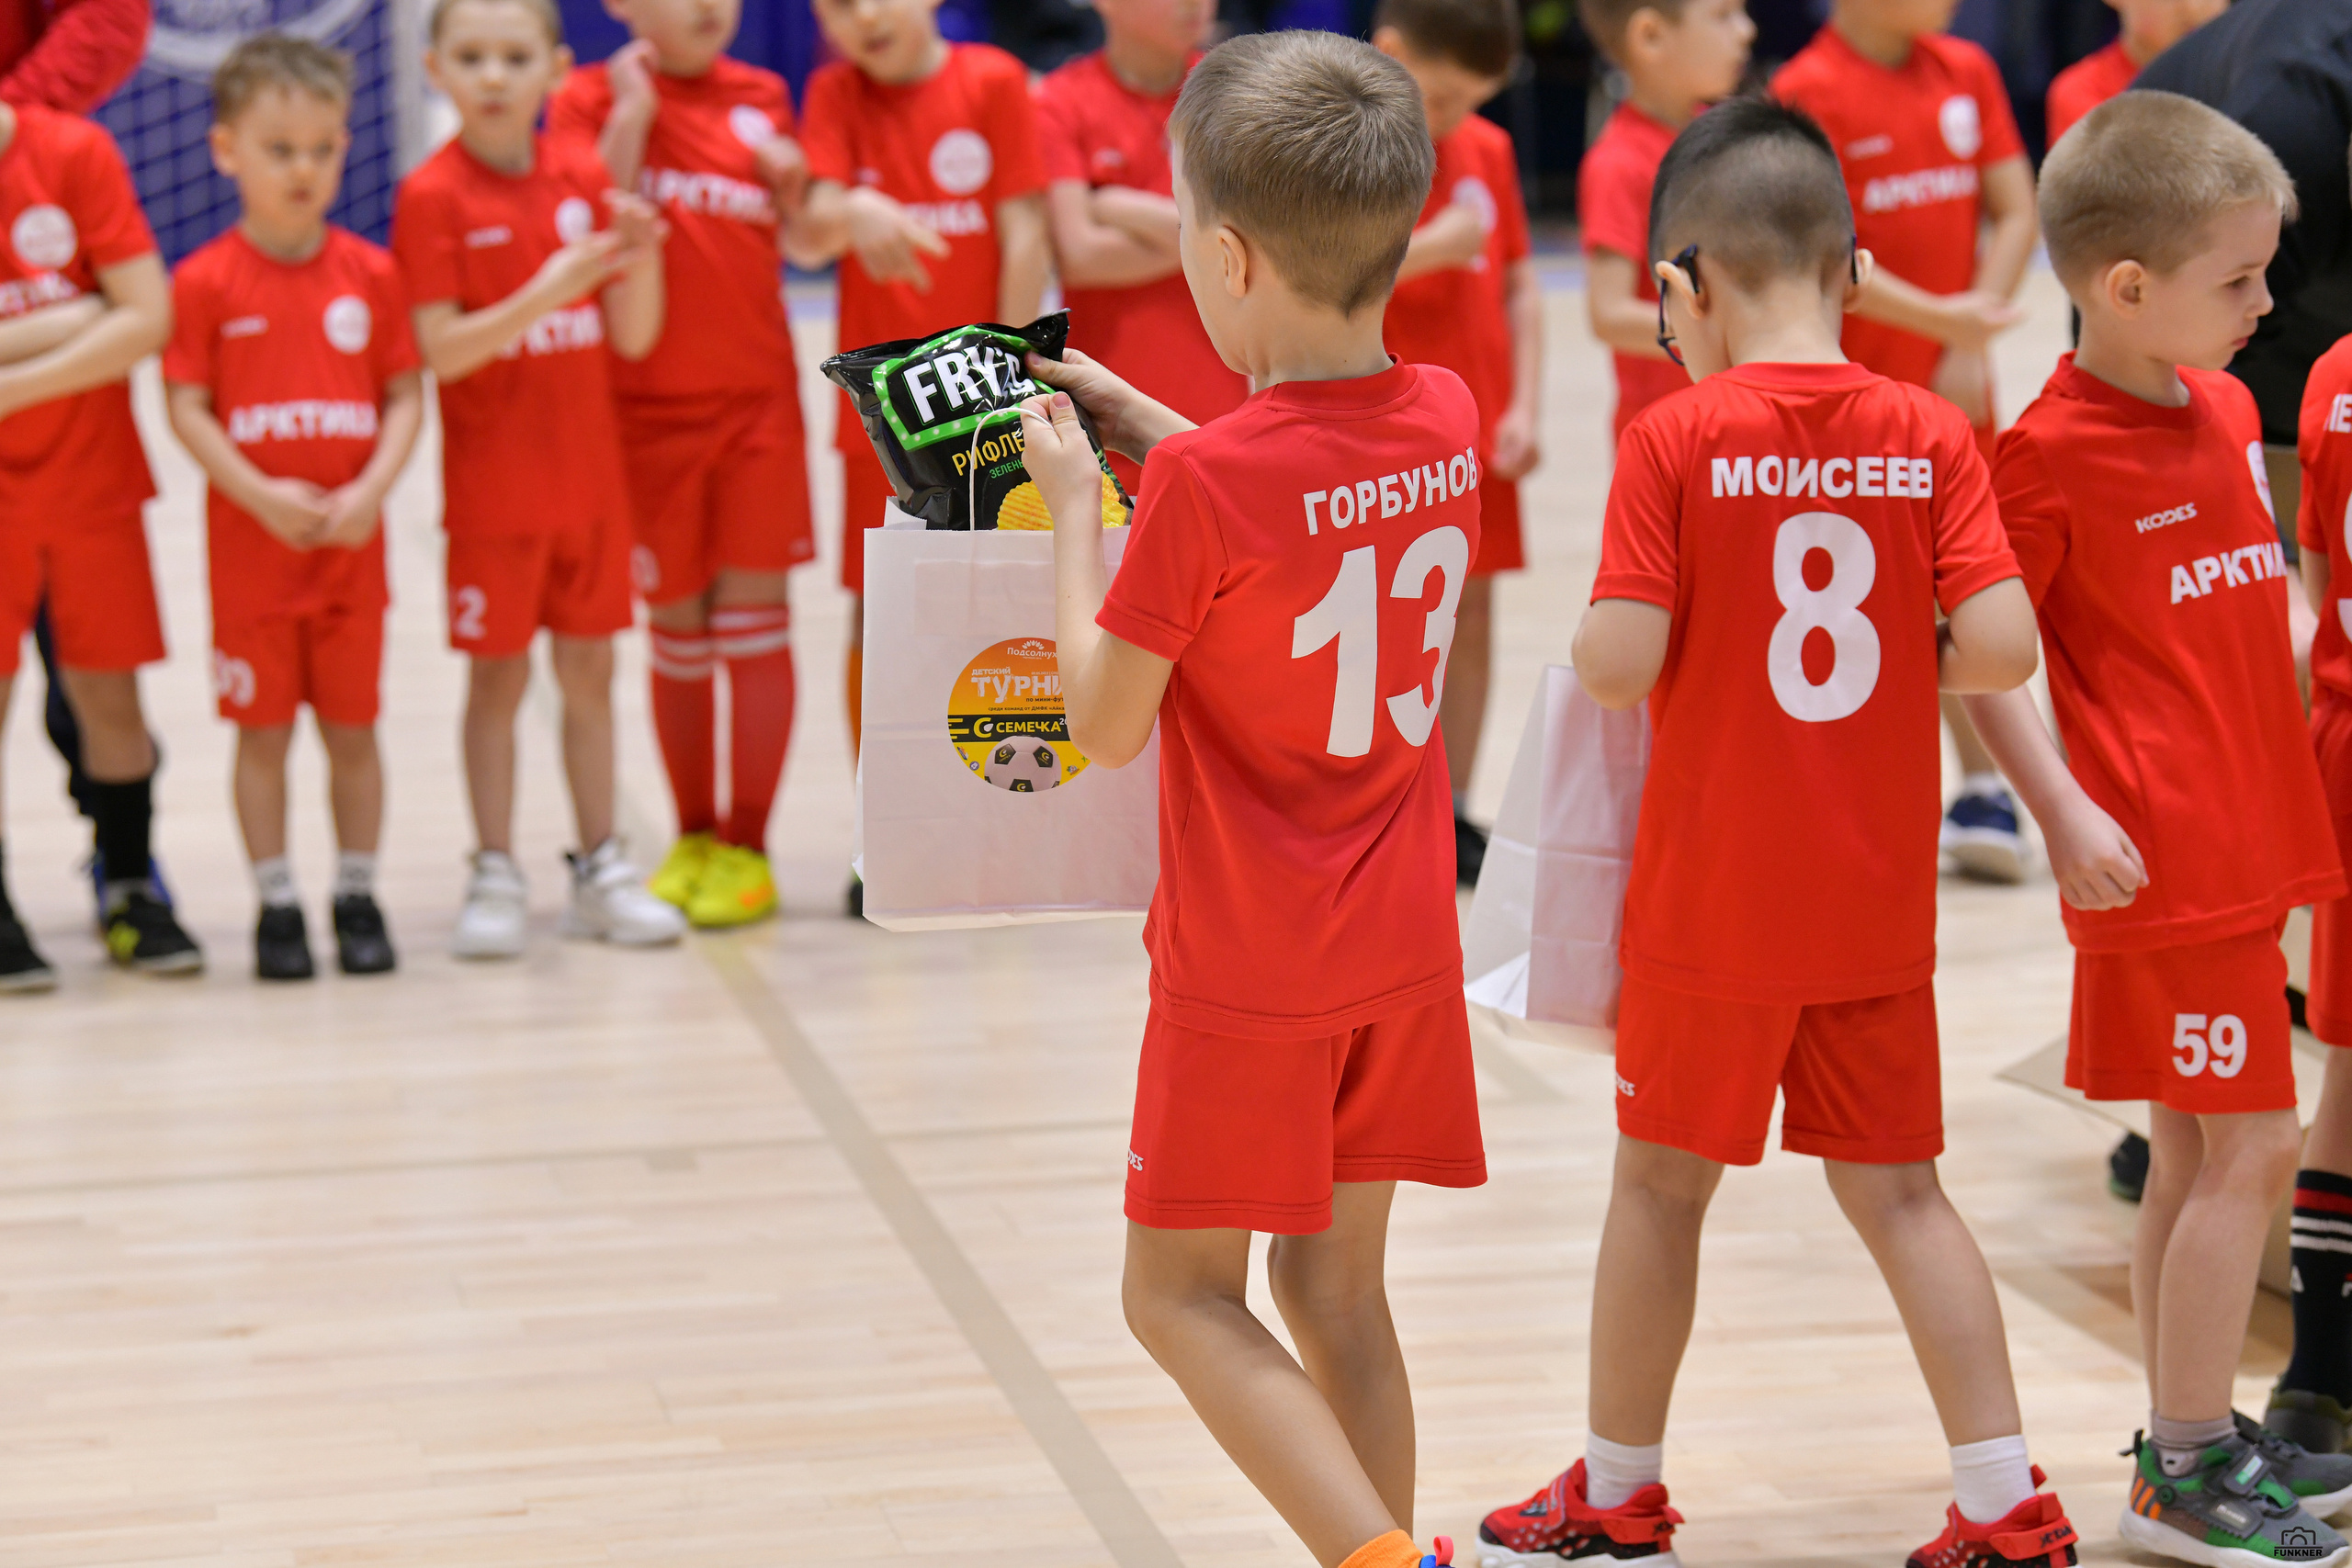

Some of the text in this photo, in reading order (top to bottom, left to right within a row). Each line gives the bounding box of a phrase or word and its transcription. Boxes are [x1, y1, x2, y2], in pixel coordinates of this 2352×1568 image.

[1303, 446, 1477, 536] ГОРБУНОВ
[1711, 455, 1933, 499] МОИСЕЕВ
[2135, 502, 2198, 534] KODES
[1292, 525, 1469, 757] 13
[1768, 512, 1881, 722] 8
[971, 667, 1011, 676] ДЕТСКИЙ
[996, 721, 1061, 733] СЕМЕЧКА
[2172, 1013, 2247, 1078] 59
